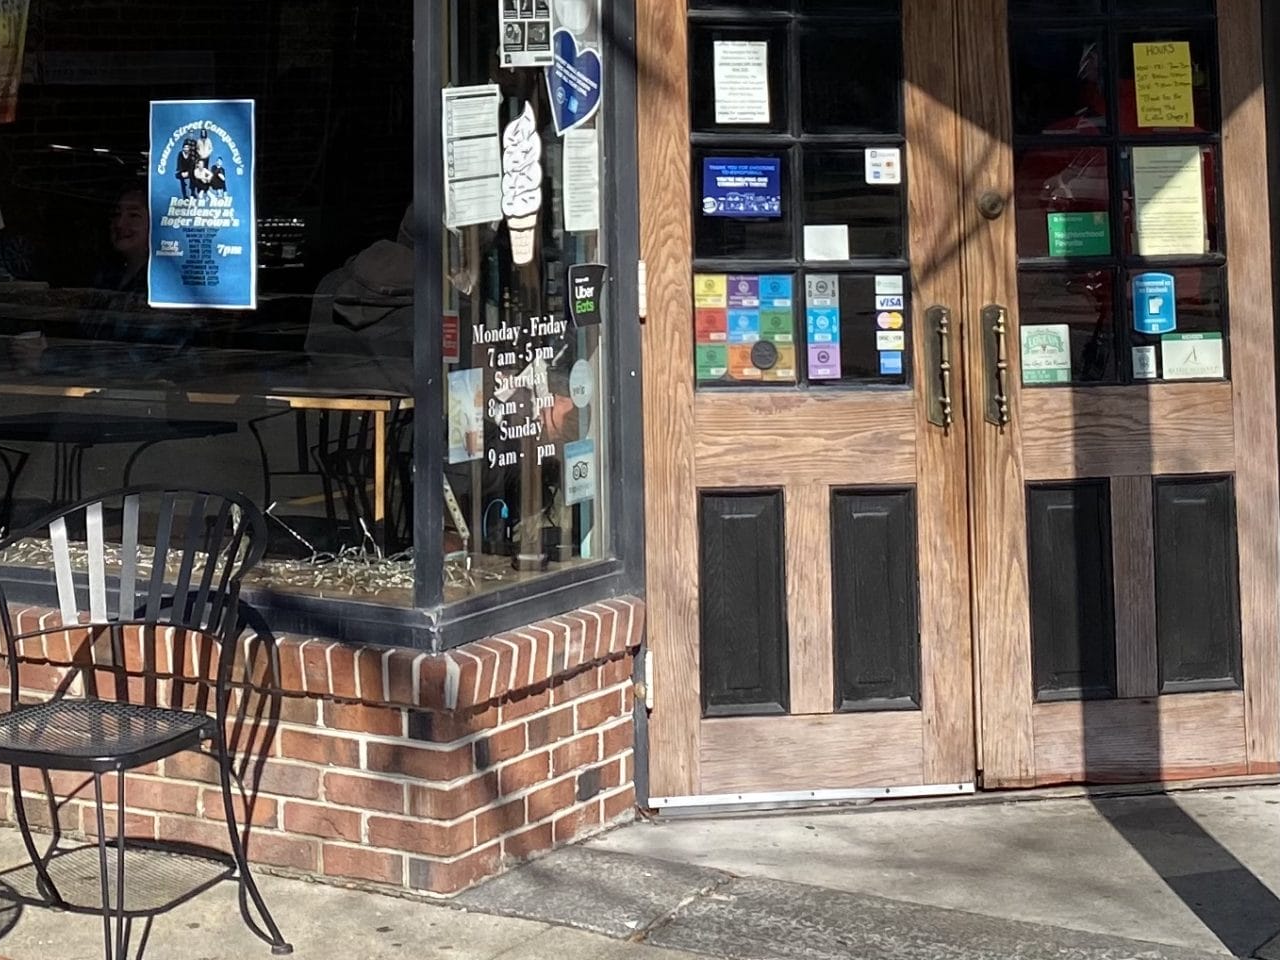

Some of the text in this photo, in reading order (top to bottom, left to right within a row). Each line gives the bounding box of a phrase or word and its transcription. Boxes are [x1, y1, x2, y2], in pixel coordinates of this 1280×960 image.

[1145, 43, 1175, 57] HOURS
[157, 119, 245, 176] Court Street Company's
[170, 196, 196, 207] Rock
[210, 196, 233, 207] Roll
[167, 206, 235, 218] Residency at
[160, 216, 240, 229] Roger Brown's
[216, 243, 243, 257] 7pm
[574, 285, 595, 299] Uber
[575, 300, 595, 314] Eats
[879, 297, 901, 307] VISA
[472, 321, 520, 346] Monday
[530, 315, 568, 339] Friday
[487, 348, 494, 367] 7
[497, 352, 515, 367] am
[525, 342, 533, 362] 5
[535, 345, 554, 367] pm
[493, 369, 548, 393] Saturday
[488, 398, 496, 418] 8
[496, 401, 517, 417] am
[536, 395, 555, 416] pm
[499, 417, 544, 441] Sunday
[488, 448, 496, 469] 9
[498, 451, 517, 467] am
[537, 443, 556, 466] pm
